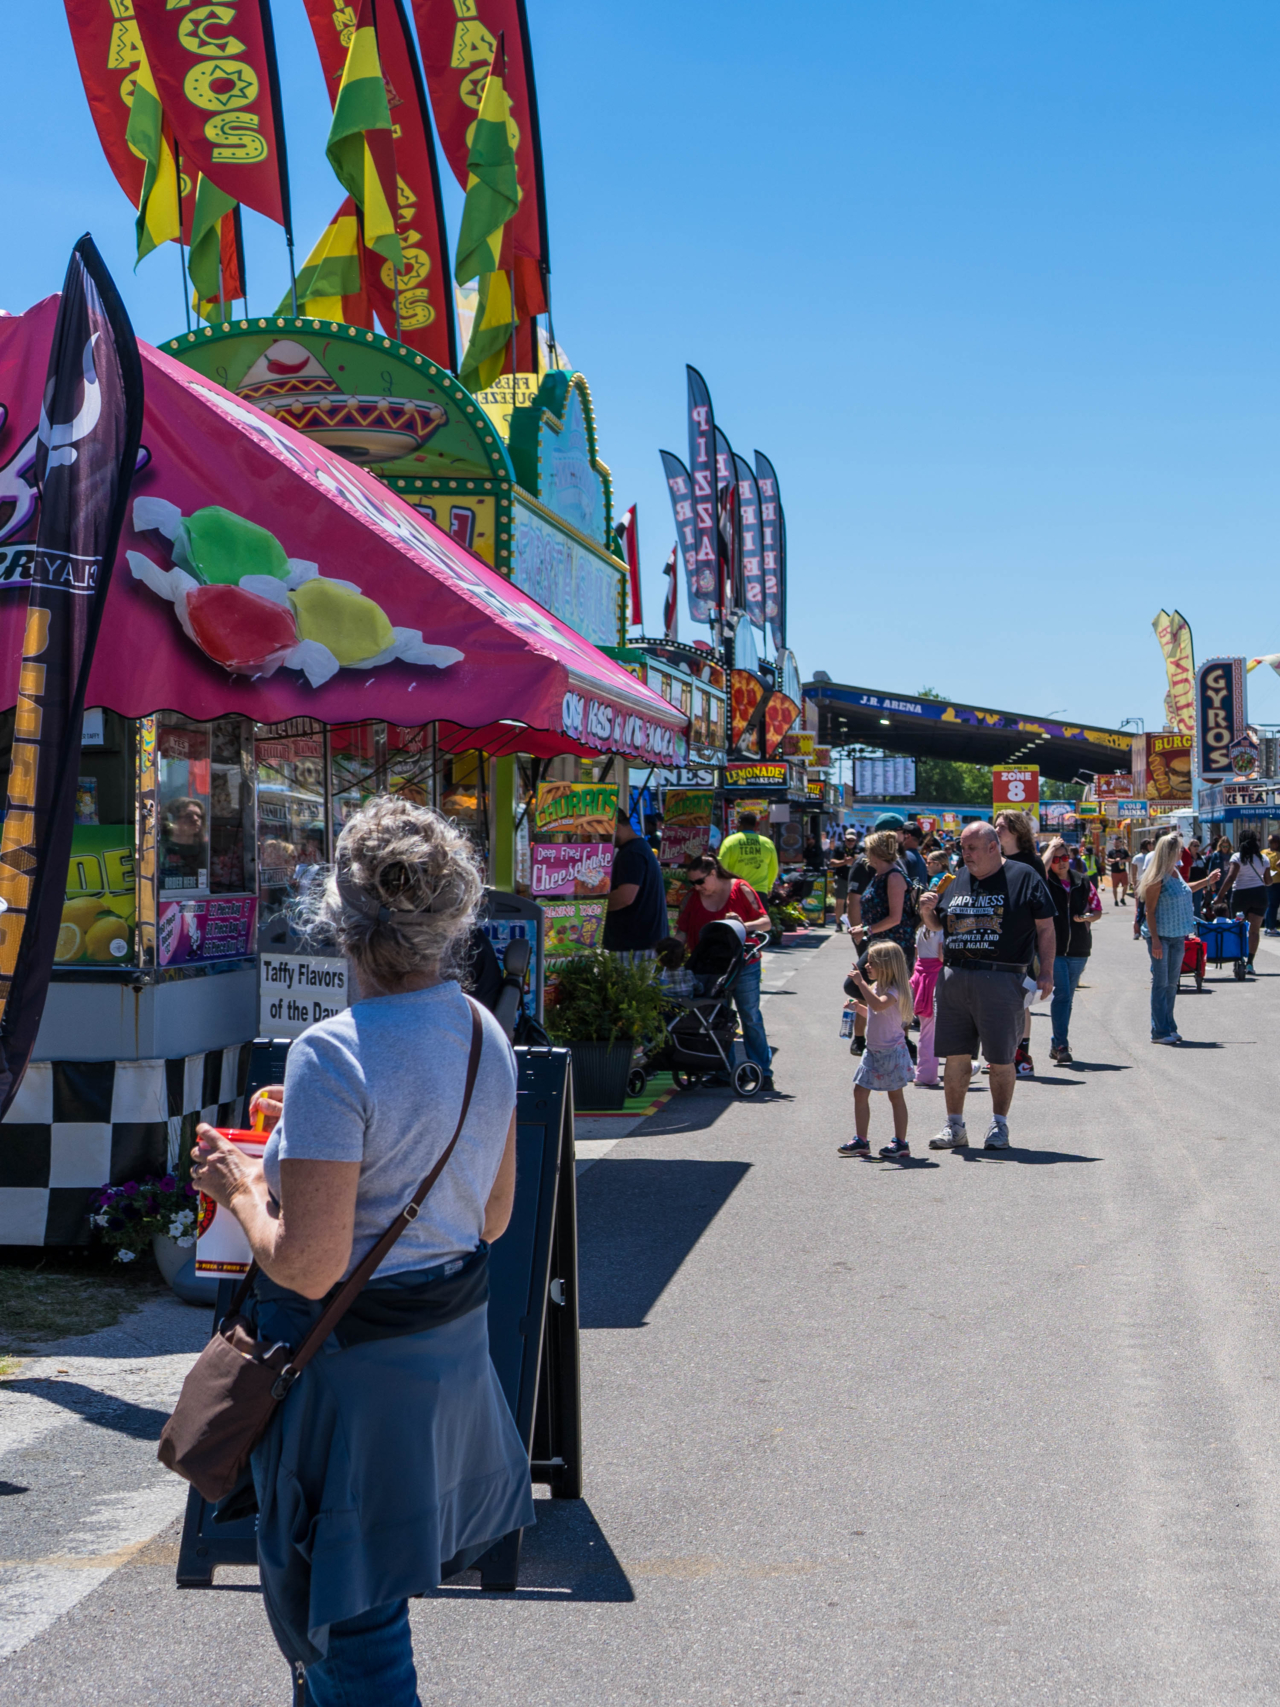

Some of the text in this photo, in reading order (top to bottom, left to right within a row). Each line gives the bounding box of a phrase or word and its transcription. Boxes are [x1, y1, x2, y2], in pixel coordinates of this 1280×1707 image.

[165, 0, 268, 163] COS
[860, 695, 923, 714] J.R. ARENA
[1205, 669, 1231, 769] GYROS
[173, 739, 186, 748] YES
[1154, 735, 1192, 751] BURG
[660, 769, 713, 785] NES
[726, 766, 785, 784] LEMONADE!
[1001, 772, 1032, 781] ZONE
[1007, 781, 1026, 802] 8
[1225, 794, 1265, 804] ICE TEA
[535, 787, 619, 828] CHURROS
[923, 822, 930, 831] 9
[739, 838, 761, 846] CLEAN
[537, 846, 581, 863] Deep Fried
[740, 847, 762, 855] TEAM
[64, 847, 136, 899] DE
[532, 843, 613, 892] Cheesecake
[184, 876, 197, 888] HERE
[949, 895, 1005, 907] HAPPINESS
[543, 904, 603, 918] ALKING TACO
[263, 960, 345, 989] Taffy Flavors
[270, 1001, 283, 1020] of
[286, 1000, 309, 1021] the
